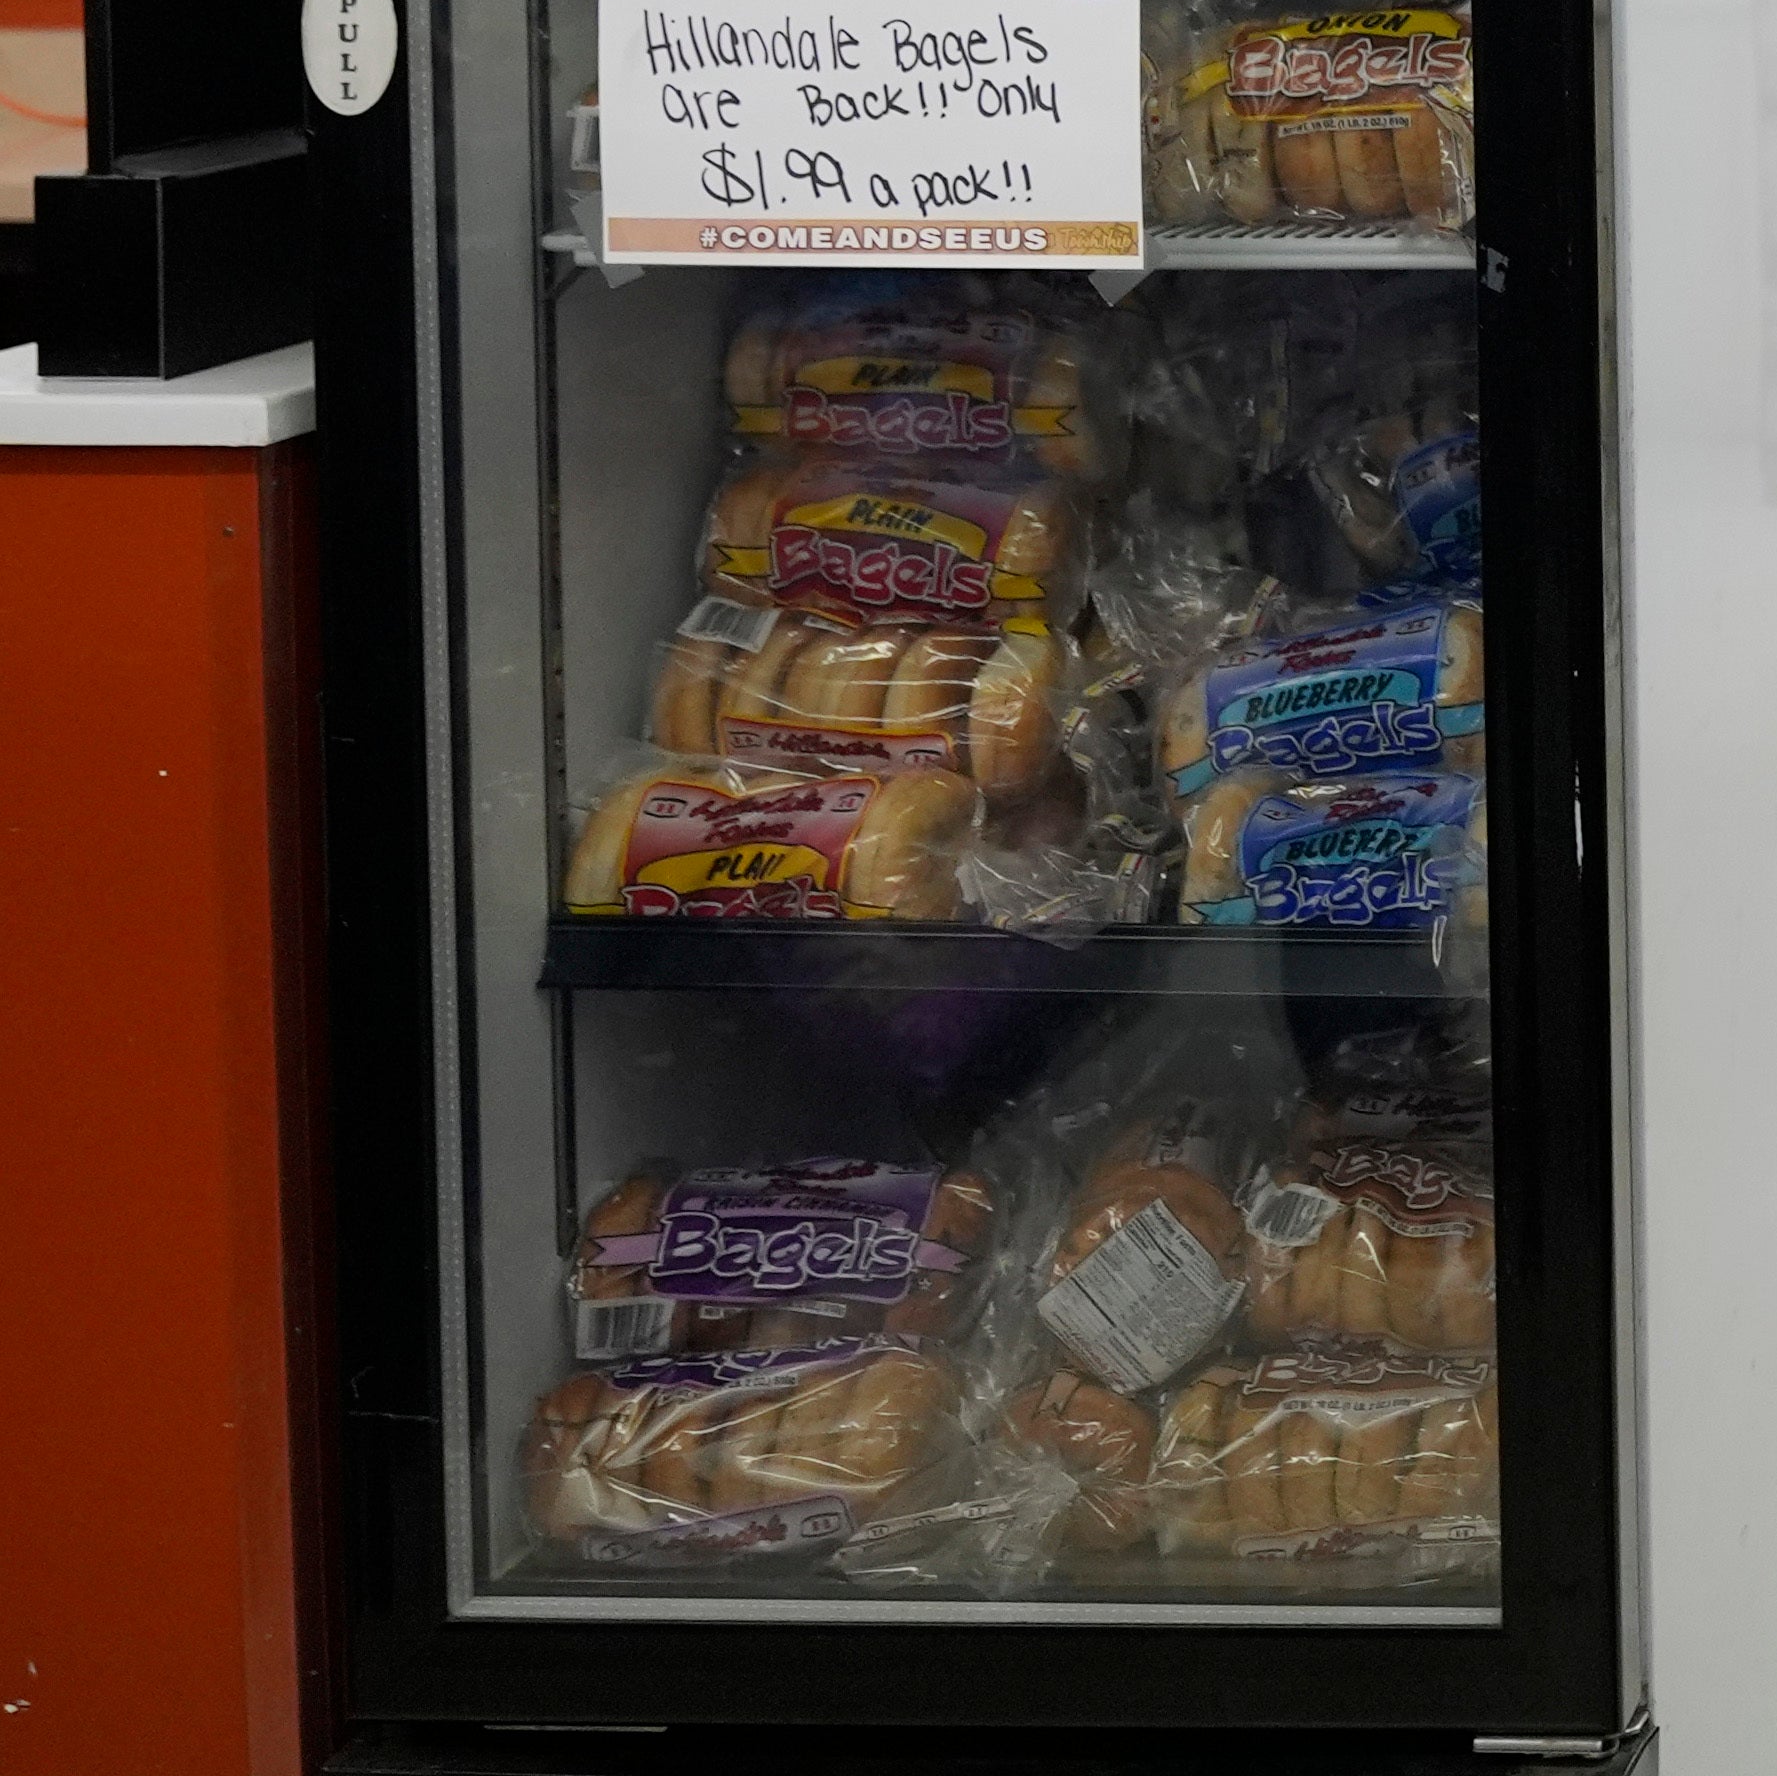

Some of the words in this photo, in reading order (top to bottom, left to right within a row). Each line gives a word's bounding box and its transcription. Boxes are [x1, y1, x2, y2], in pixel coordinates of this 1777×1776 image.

[643, 9, 861, 75] Hillandale
[882, 13, 1049, 92] Bagels
[1306, 12, 1412, 34] ONION
[1226, 34, 1471, 101] Bagels
[662, 84, 741, 130] are
[797, 81, 948, 127] Back!!
[701, 142, 852, 210] $1.99
[870, 173, 899, 208] a
[911, 160, 1032, 218] pack!!
[699, 224, 1049, 251] #COMEANDSEEUS
[785, 387, 1011, 454] Bagels
[768, 525, 994, 609] Bagels
[1244, 672, 1394, 723] BLUEBERRY
[1209, 701, 1443, 774] Bagels
[649, 1212, 921, 1291] Bagels
